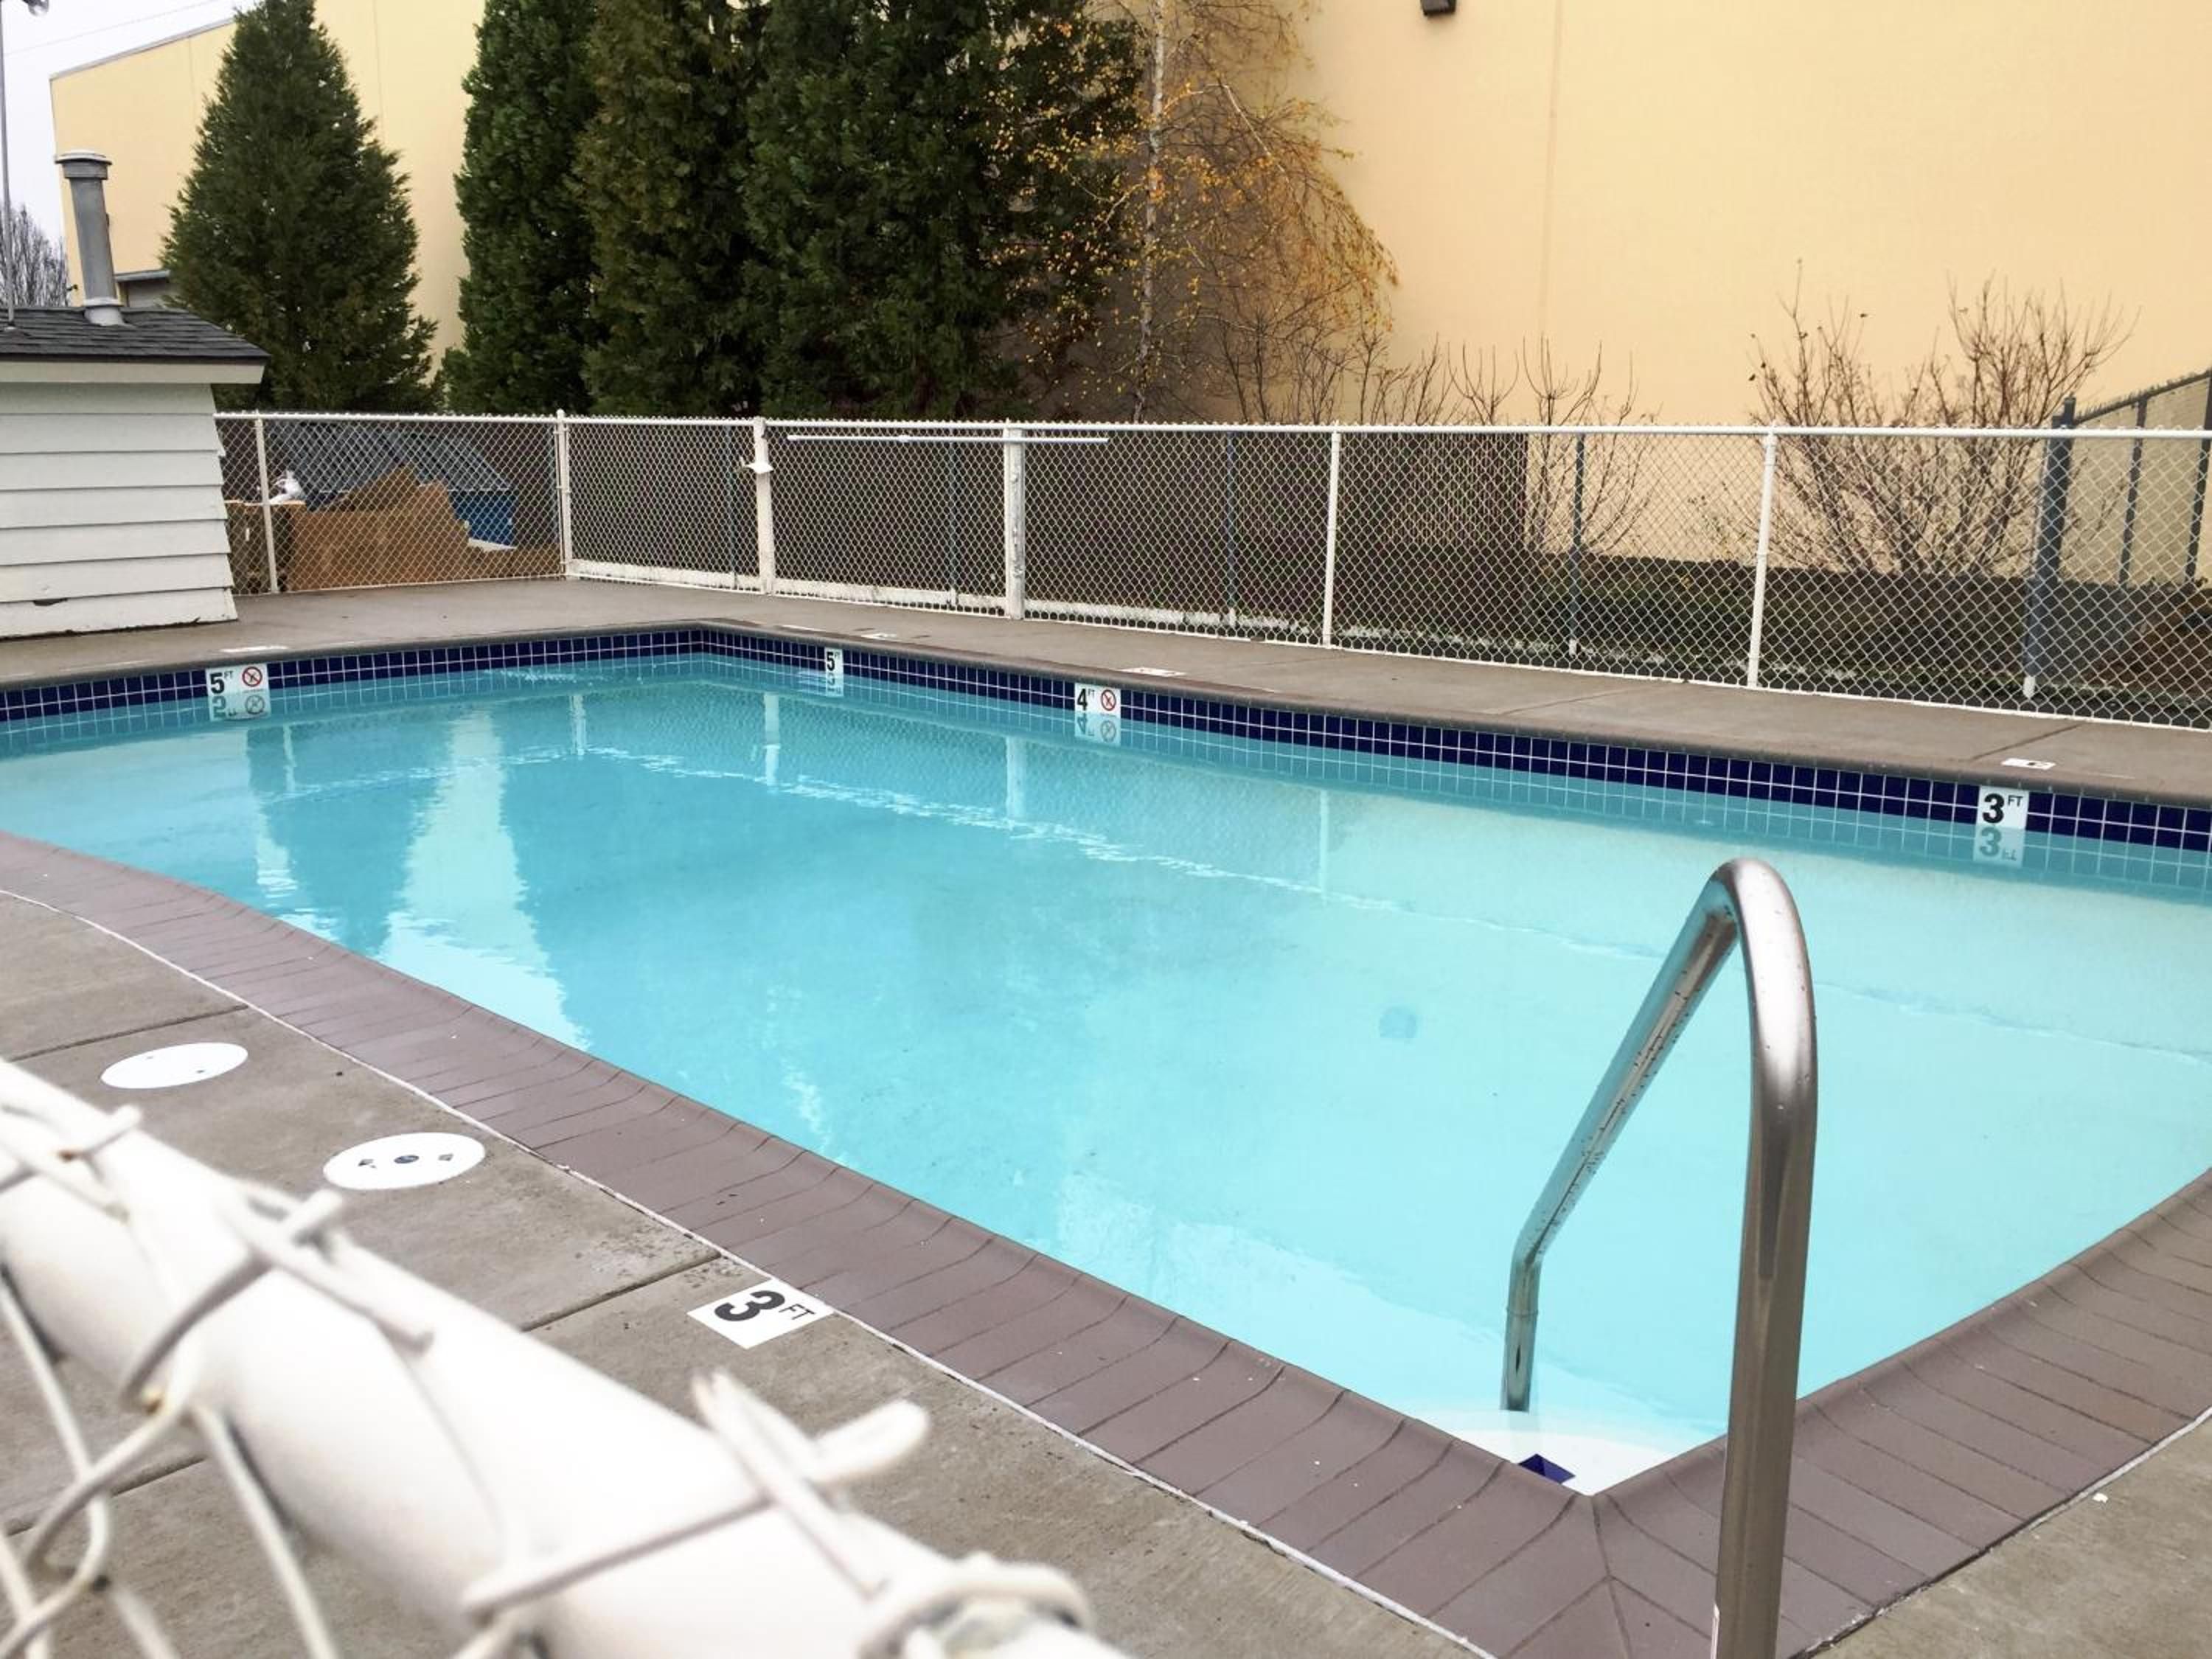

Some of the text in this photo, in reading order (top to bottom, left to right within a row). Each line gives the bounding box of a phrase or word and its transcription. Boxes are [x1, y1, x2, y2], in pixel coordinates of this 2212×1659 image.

[827, 651, 835, 672] 5
[209, 670, 234, 695] 5 FT
[1077, 688, 1088, 712] 4
[1982, 793, 2024, 824] 3 FT
[714, 1290, 816, 1322] 3 FT
